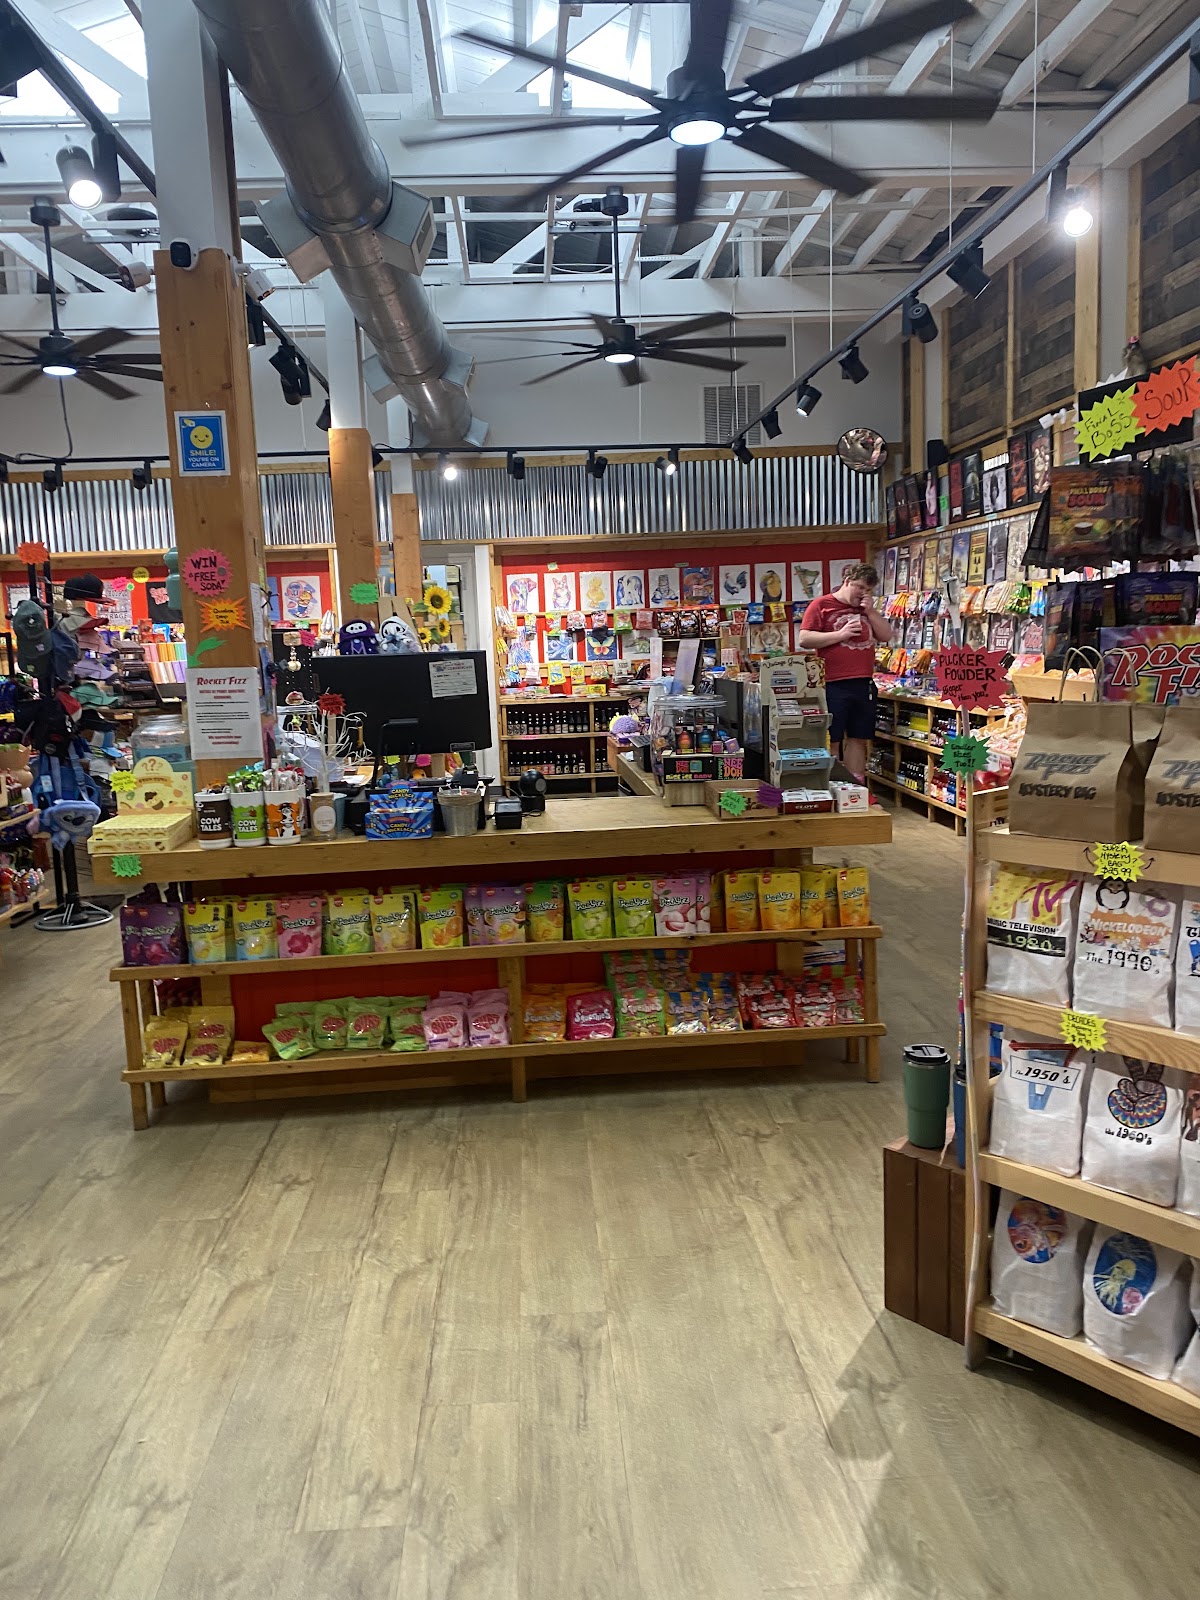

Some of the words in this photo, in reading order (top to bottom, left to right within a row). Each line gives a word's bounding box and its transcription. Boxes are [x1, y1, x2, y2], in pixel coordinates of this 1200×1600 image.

[191, 556, 217, 569] WIN
[194, 571, 216, 581] FREE
[939, 653, 987, 667] PUCKER
[197, 676, 227, 685] ROCKET
[229, 676, 247, 685] FIZZ
[944, 667, 996, 682] POWDER
[724, 757, 743, 769] NEE
[724, 766, 743, 778] DOH
[1019, 783, 1073, 798] MYSTERY
[1074, 786, 1097, 800] BAG
[201, 824, 222, 832] TALES
[1009, 922, 1056, 935] TELEVISION
[1091, 919, 1167, 937] NICKELODEON
[1086, 952, 1103, 964] The
[1024, 1066, 1071, 1084] 1950's
